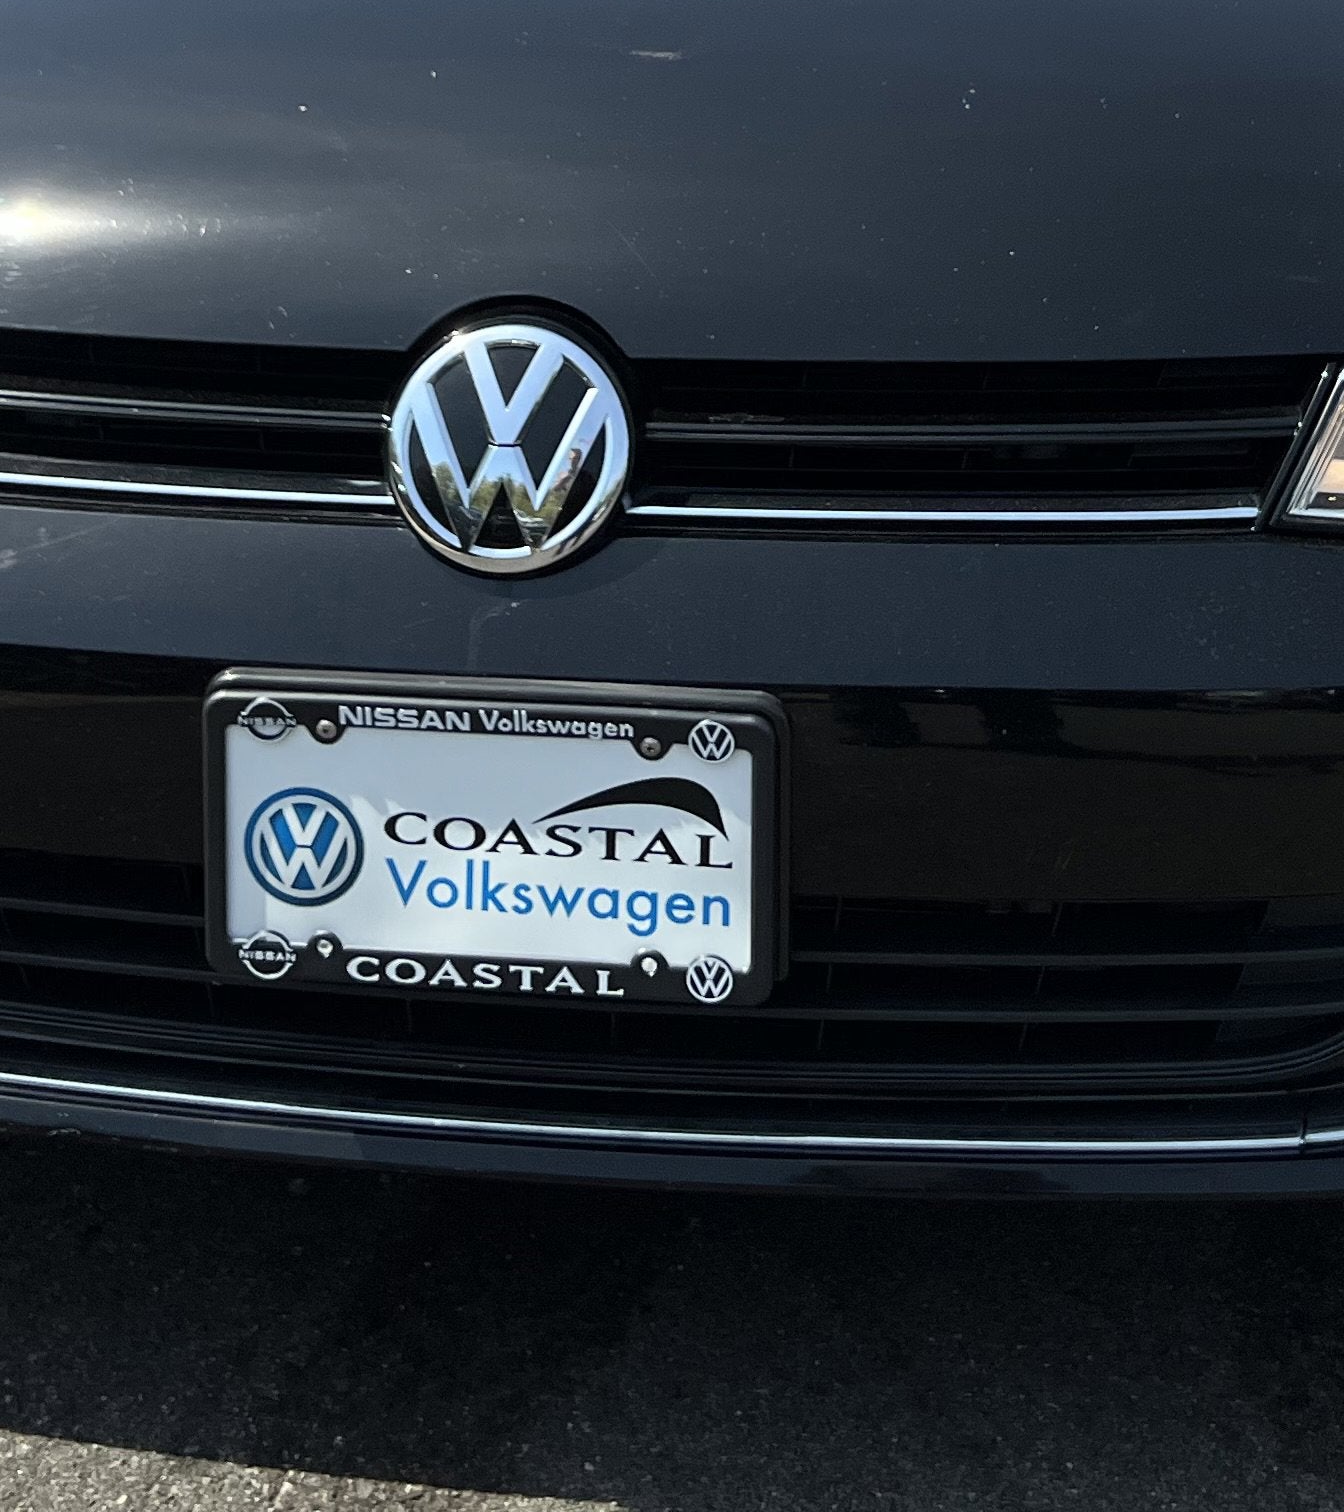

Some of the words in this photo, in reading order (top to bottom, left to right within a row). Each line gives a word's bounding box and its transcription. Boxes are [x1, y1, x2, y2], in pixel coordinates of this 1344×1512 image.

[401, 334, 620, 558] VW
[338, 705, 471, 732] NISSAN
[479, 709, 635, 739] Volkswagen
[252, 794, 358, 900] VW
[384, 811, 734, 869] COASTAL
[385, 857, 732, 936] Volkswagen
[238, 949, 297, 962] NISSAN
[346, 955, 625, 998] COASTAL
